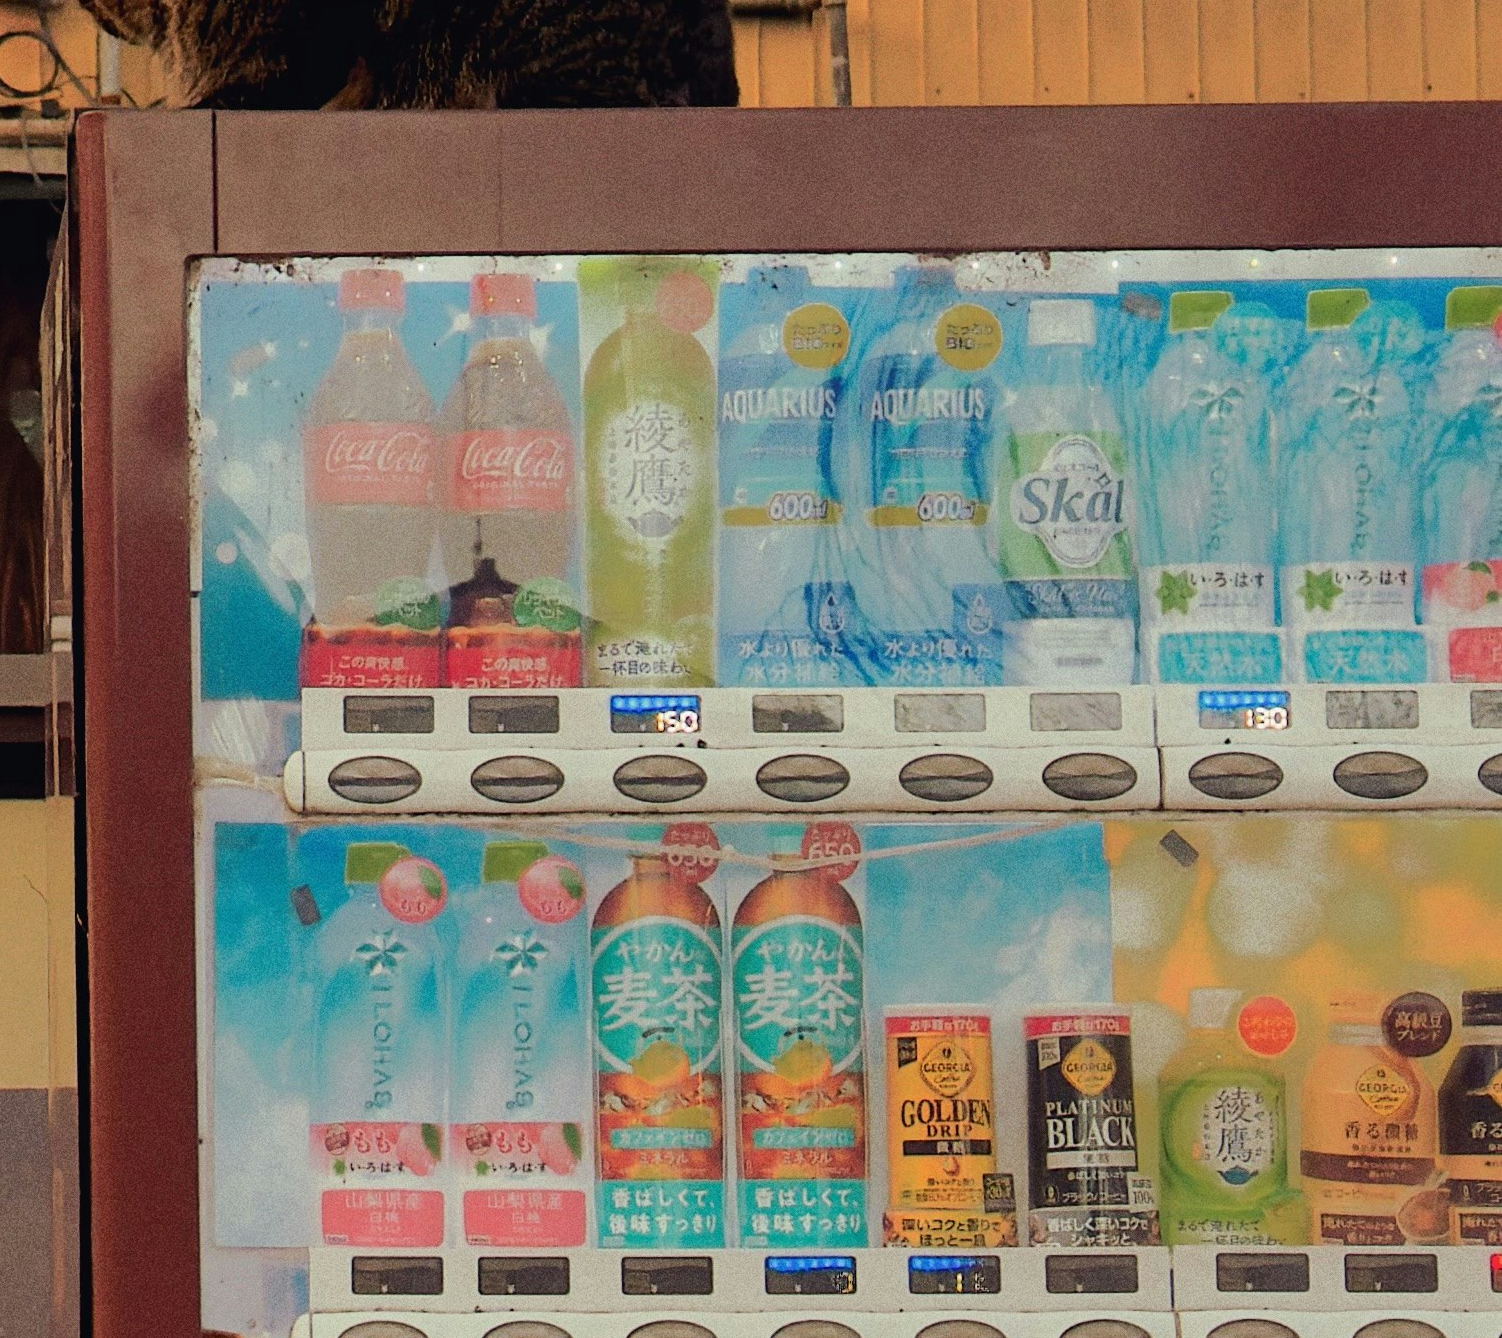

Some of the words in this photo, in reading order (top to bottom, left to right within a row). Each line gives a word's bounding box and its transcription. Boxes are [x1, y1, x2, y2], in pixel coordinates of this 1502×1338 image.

[722, 388, 837, 422] AQUARIUS
[870, 389, 985, 421] AQUARIUS
[625, 403, 677, 509] 綾鷹
[656, 712, 698, 733] 150
[1245, 708, 1288, 729] 130
[599, 965, 717, 1031] 麦茶
[739, 965, 857, 1031] 麦茶
[923, 1062, 970, 1073] GEORGIA
[901, 1099, 991, 1128] GOLDEN
[1044, 1100, 1133, 1116] PLATINUM
[926, 1124, 972, 1138] DRIP
[1046, 1116, 1135, 1149] BLACK
[1214, 1086, 1252, 1162] 綾鷹
[611, 1187, 715, 1209] 香ばしくて、
[754, 1186, 859, 1208] 香ばしくて、
[609, 1214, 717, 1235] 後味すっきり
[751, 1212, 860, 1234] 後味すっきり
